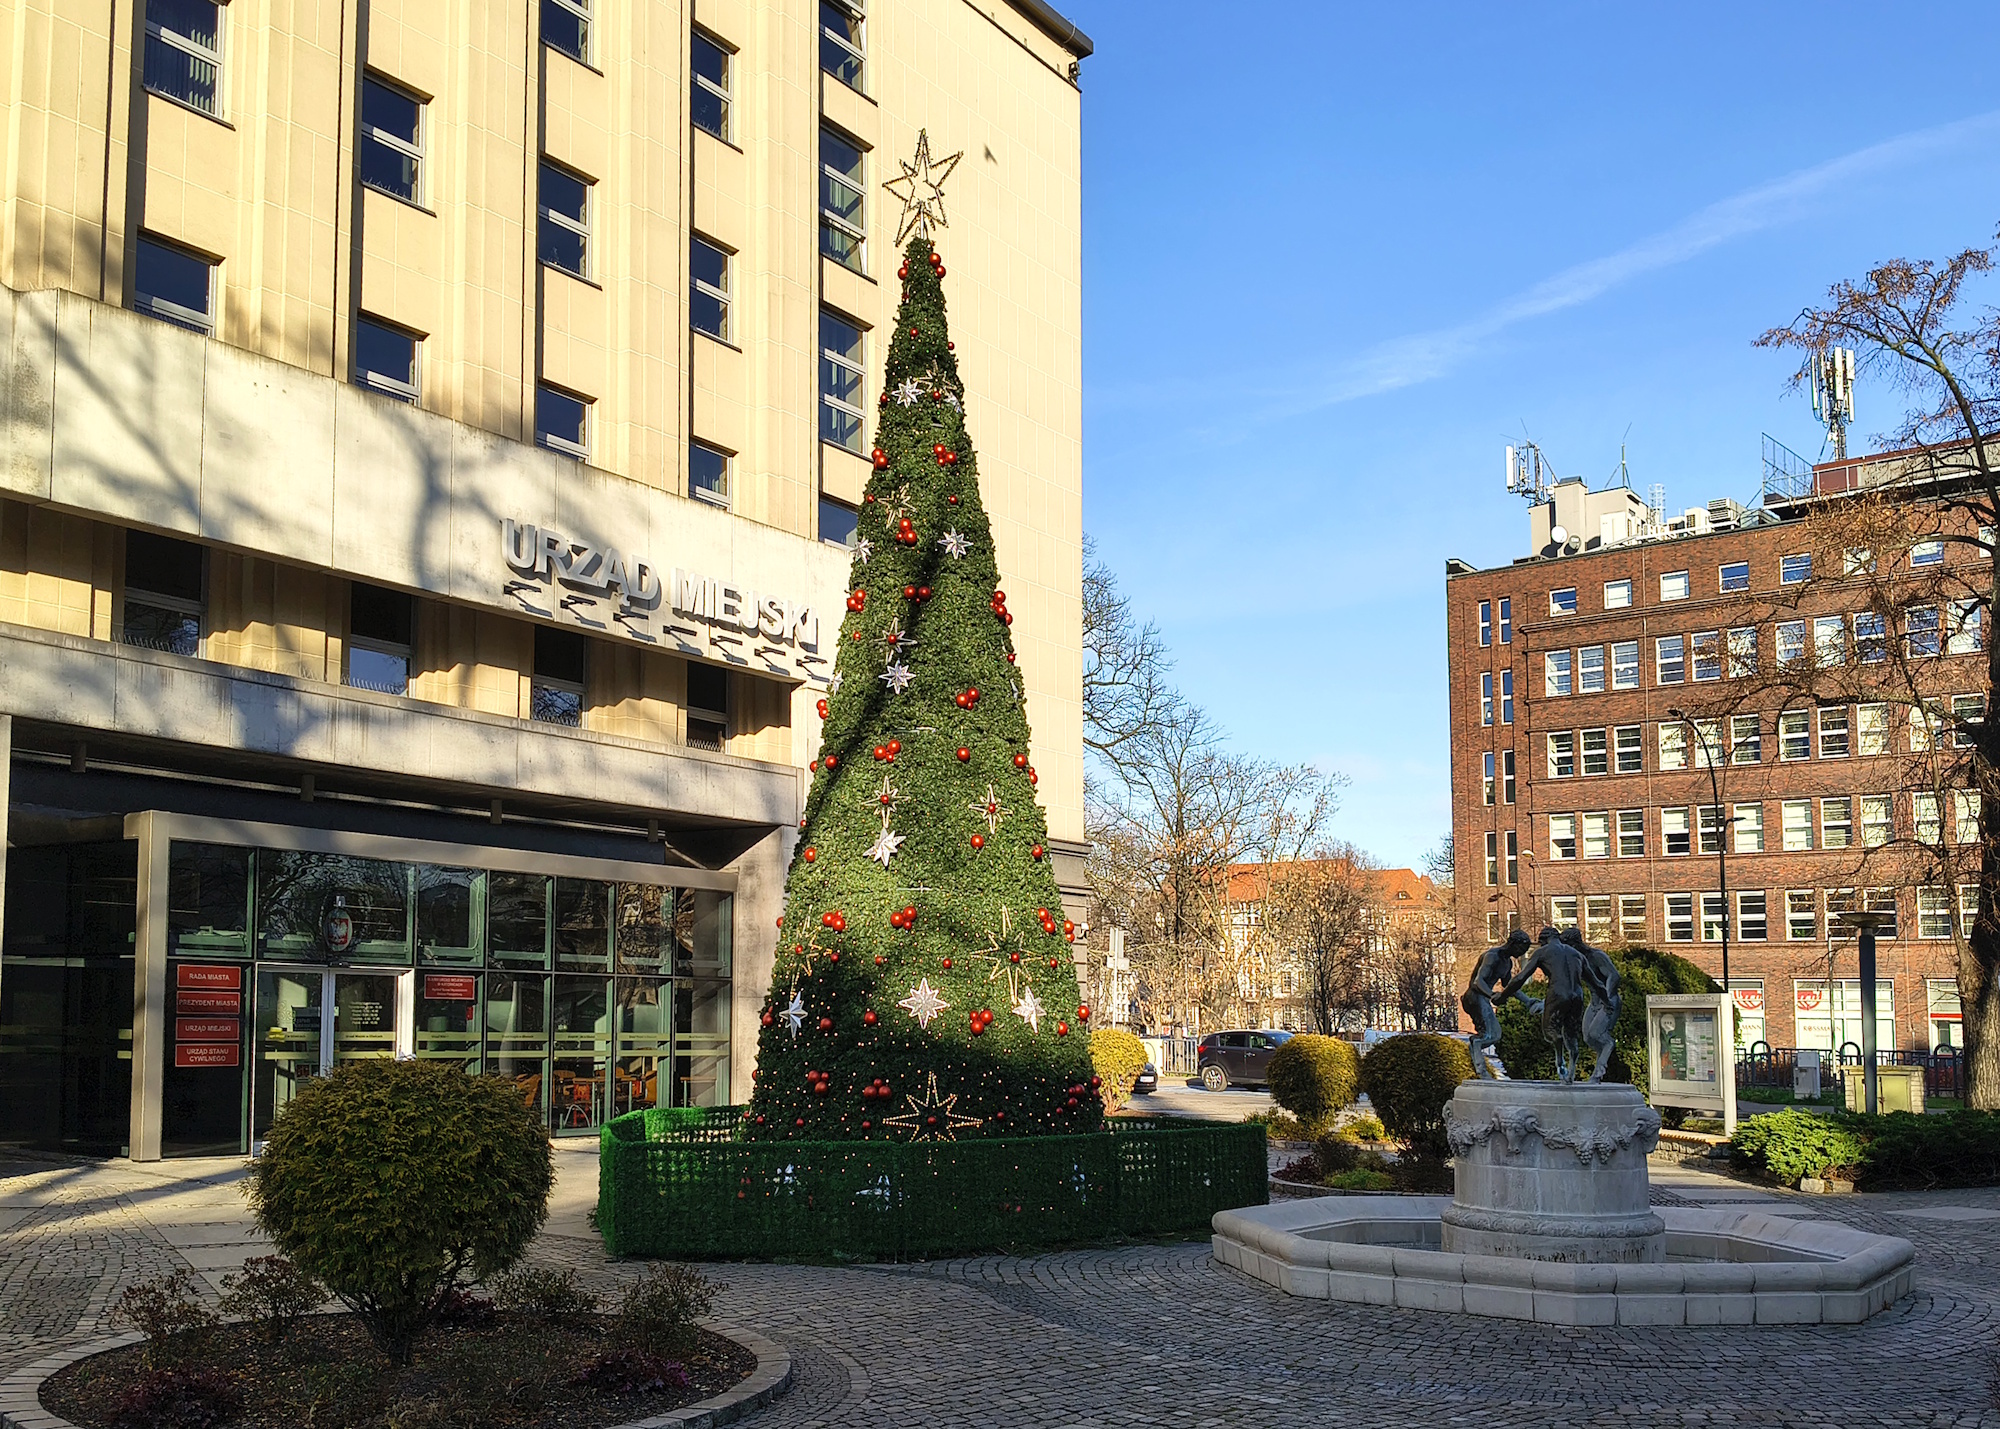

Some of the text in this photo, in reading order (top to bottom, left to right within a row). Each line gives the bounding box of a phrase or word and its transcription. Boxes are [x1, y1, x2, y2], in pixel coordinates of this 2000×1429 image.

[500, 517, 818, 649] URZĄD MIEJSKI
[207, 973, 230, 981] MIASTA
